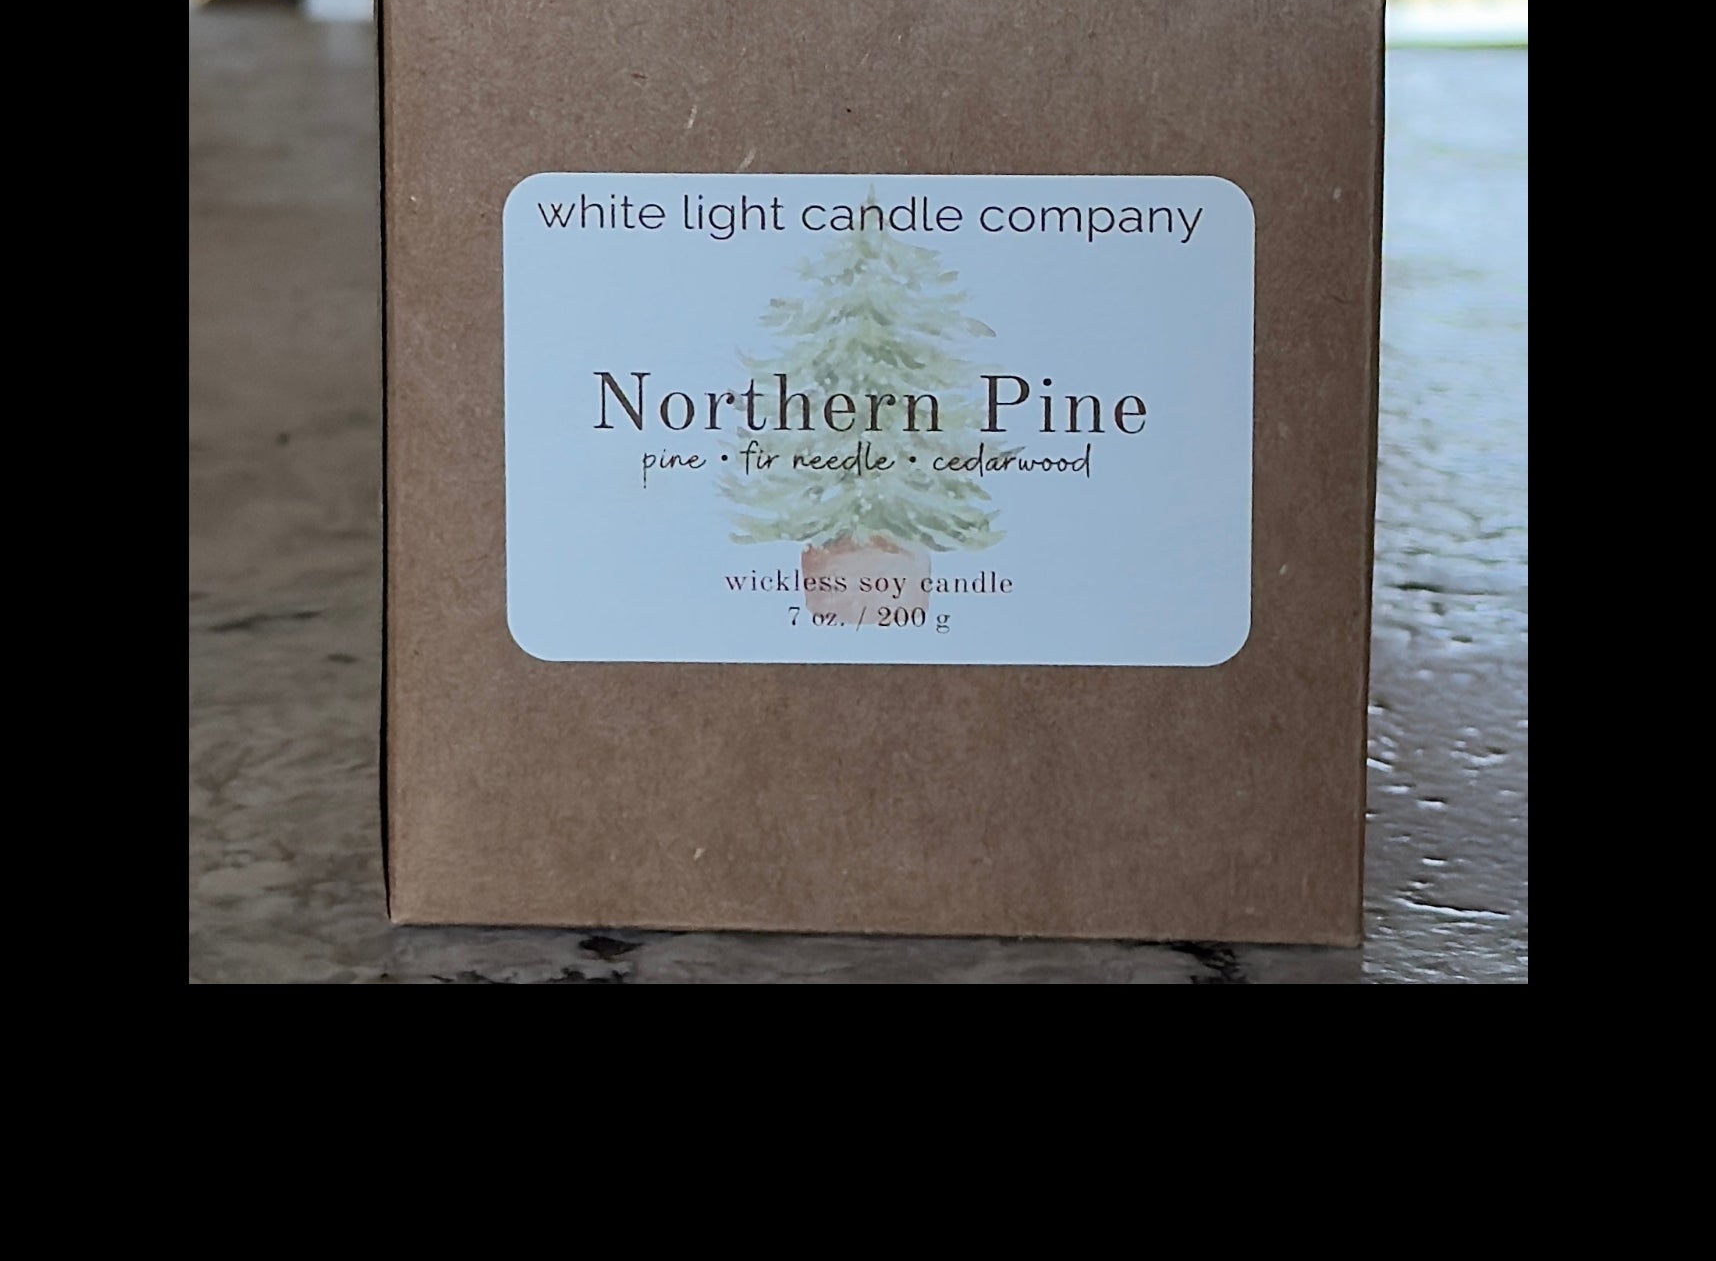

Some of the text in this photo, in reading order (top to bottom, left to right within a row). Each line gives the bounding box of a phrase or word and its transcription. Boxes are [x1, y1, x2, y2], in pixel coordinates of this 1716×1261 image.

[537, 194, 1204, 242] white light candle company
[593, 370, 1149, 435] Northern Pine
[642, 440, 1091, 489] pine fir needle cedarwood
[725, 569, 1014, 599] wickless soy candle
[788, 605, 800, 627] 7
[811, 610, 845, 627] oz.
[878, 606, 928, 628] 200
[936, 610, 952, 634] g
